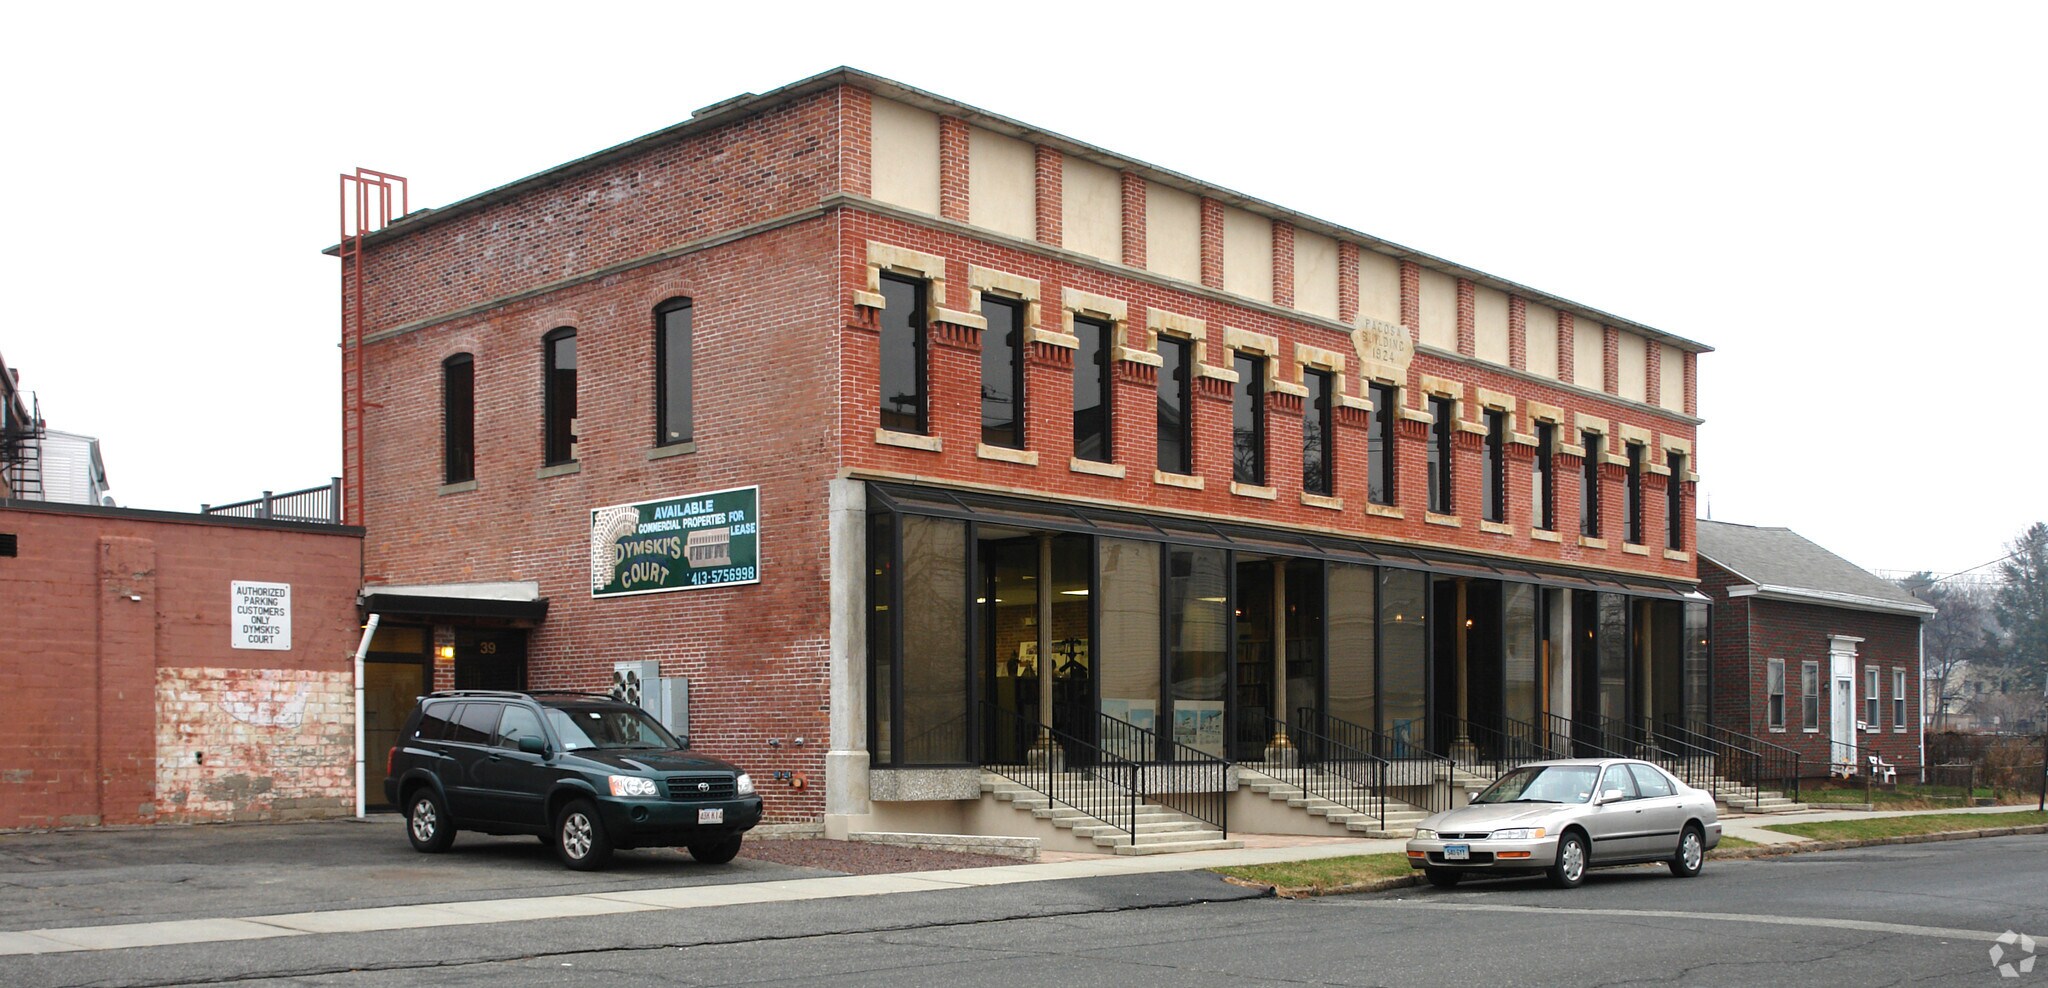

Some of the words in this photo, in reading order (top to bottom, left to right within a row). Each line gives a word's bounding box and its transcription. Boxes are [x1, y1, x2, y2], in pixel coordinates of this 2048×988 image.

[1372, 347, 1395, 363] 1924
[653, 500, 714, 520] AVAILABLE
[638, 518, 681, 534] COMMERCIAL
[682, 513, 726, 529] PROPERTIES
[728, 510, 744, 522] FOR
[730, 522, 756, 536] LEASE
[615, 536, 681, 567] DYMSKI'S
[621, 561, 669, 588] COURT
[691, 566, 755, 585] 413-5756998
[236, 586, 286, 597] AUTHORIZED
[244, 596, 278, 606] PARKING
[237, 606, 285, 616] CUSTOMERS
[251, 616, 270, 624] ONLY
[243, 625, 280, 635] DYMSKI'S
[248, 635, 274, 644] COURT
[480, 642, 496, 654] 39
